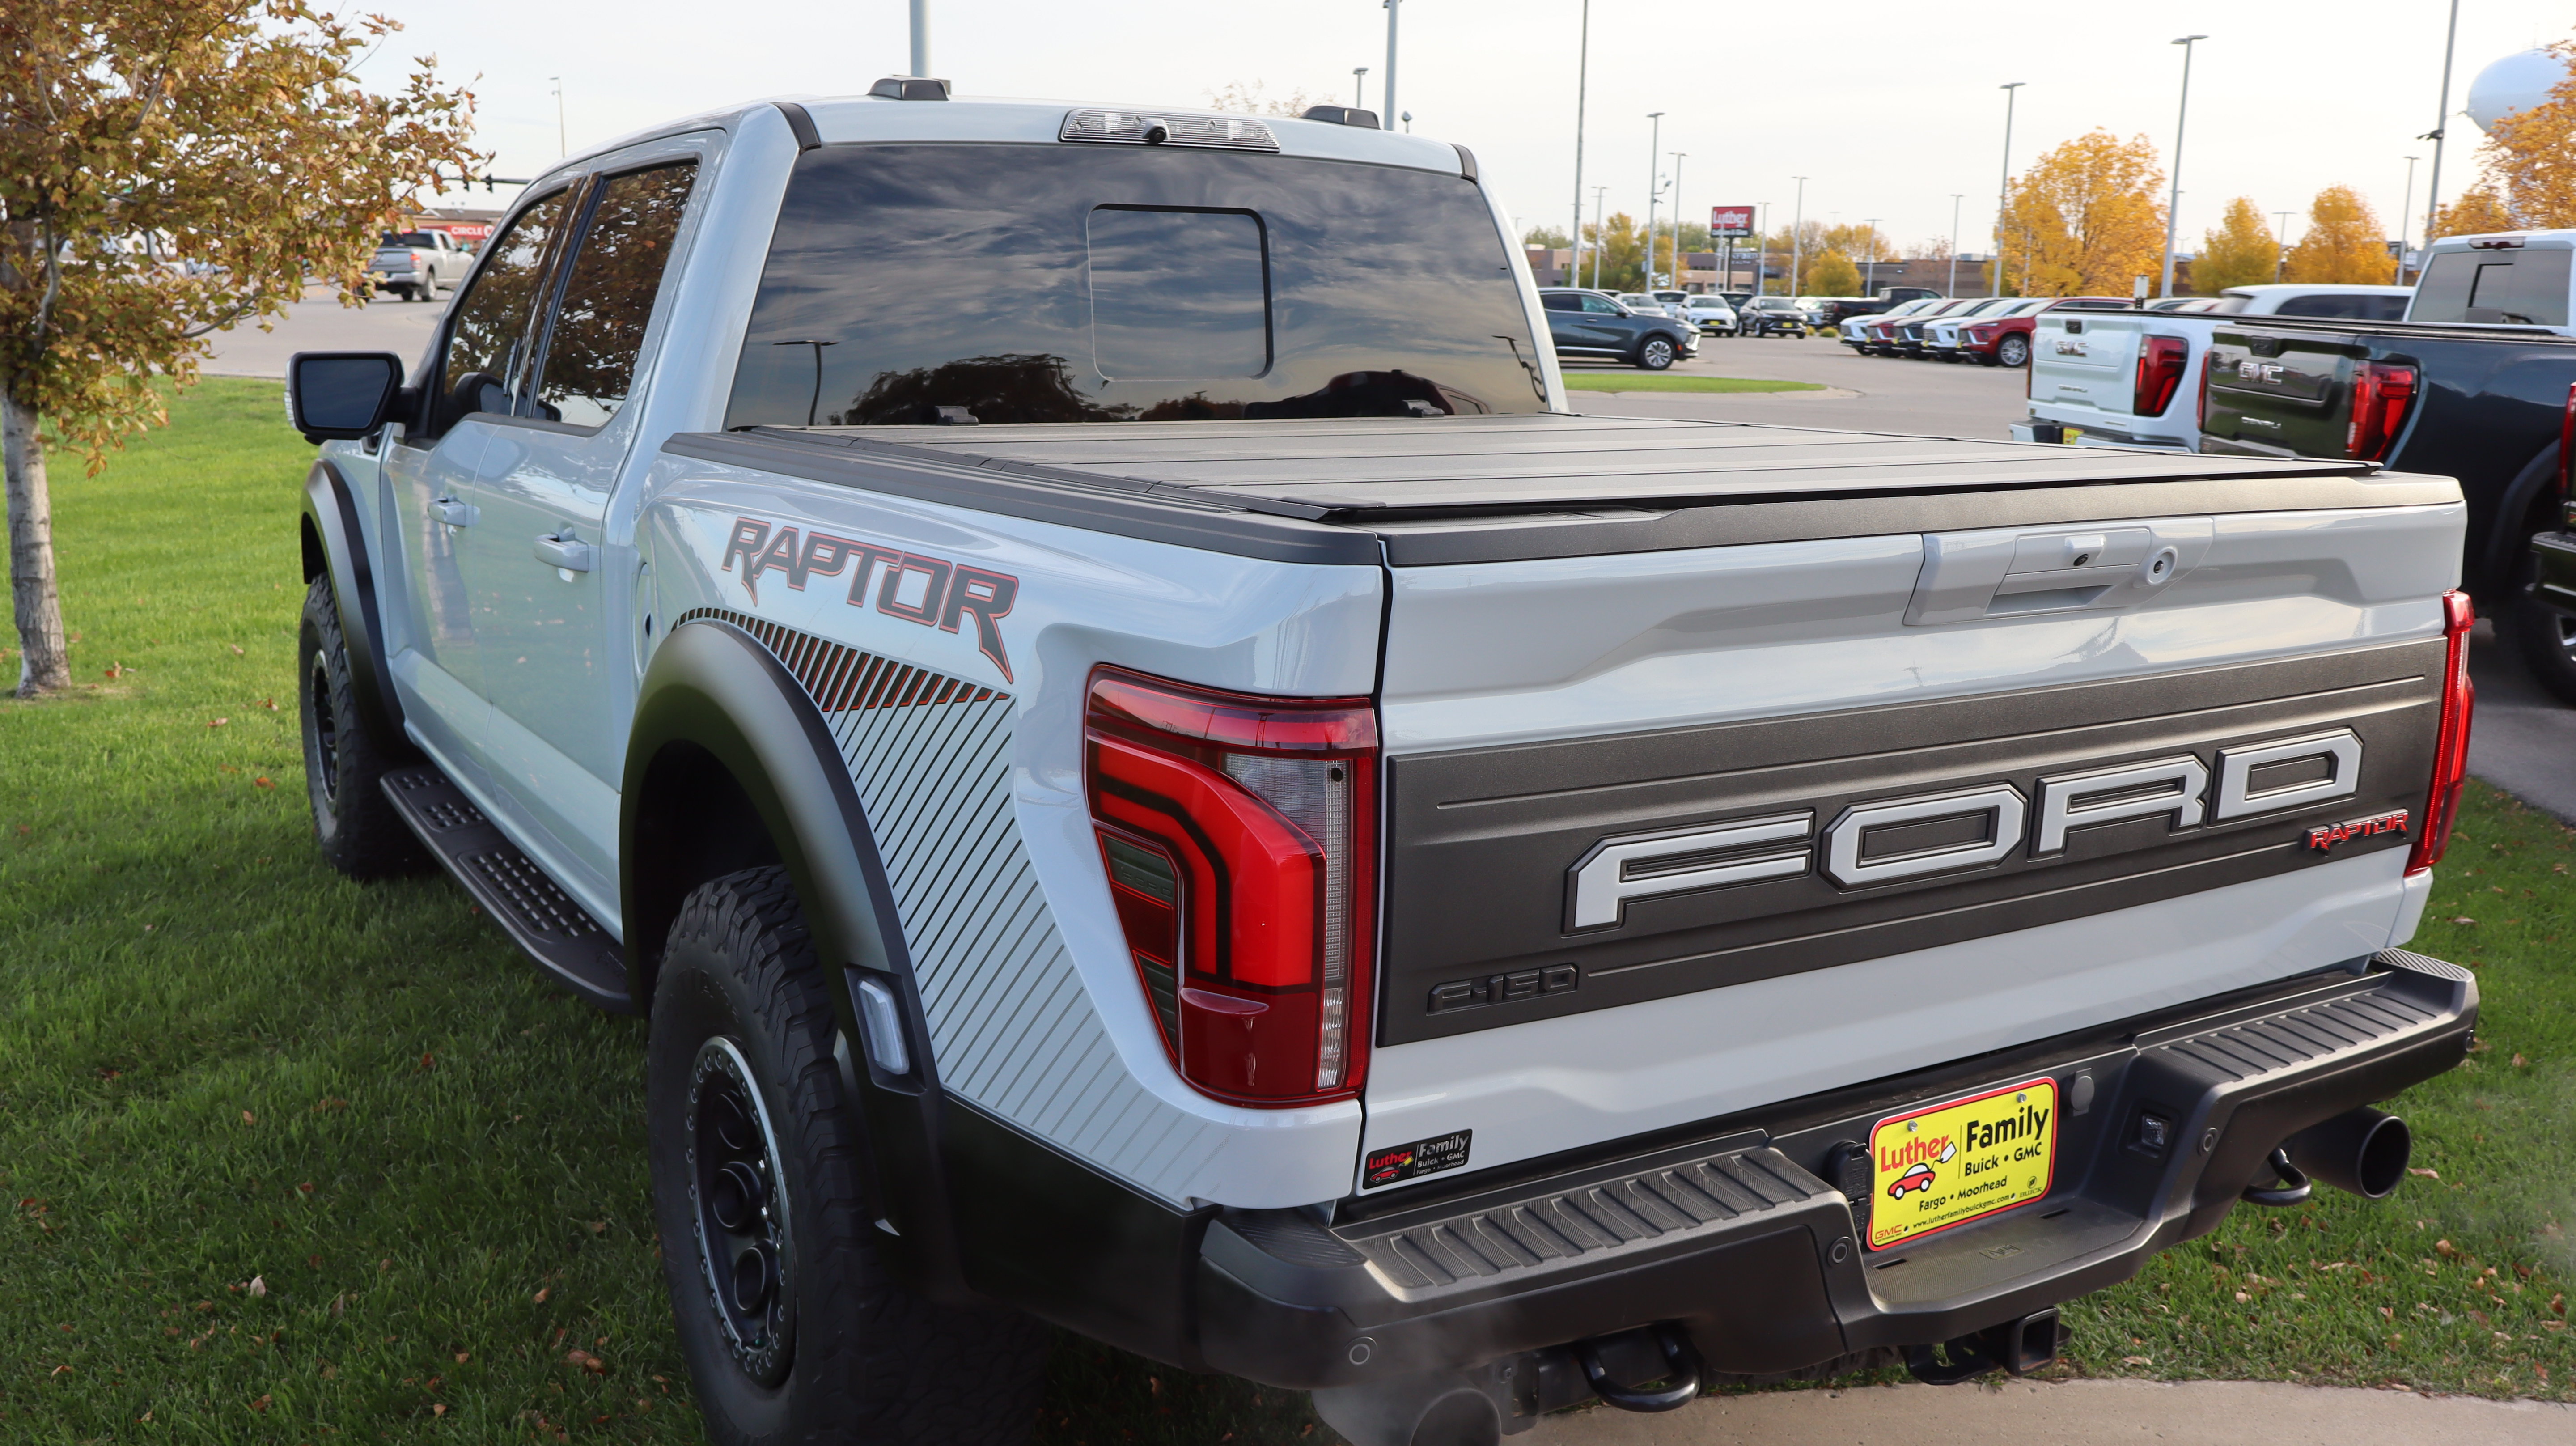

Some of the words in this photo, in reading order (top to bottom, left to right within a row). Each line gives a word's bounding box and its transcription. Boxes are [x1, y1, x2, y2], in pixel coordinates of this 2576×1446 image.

[1713, 211, 1748, 224] Luther
[451, 226, 483, 235] CIRCLE
[2056, 341, 2089, 357] GMC
[2239, 361, 2284, 385] GMC
[721, 516, 1019, 685] RAPTOR
[1565, 726, 2364, 933] FORD
[2306, 808, 2409, 852] RAPTOR
[1428, 963, 1578, 1014] F-150
[1966, 1105, 2049, 1153] Family
[1419, 1134, 1469, 1158] Family
[1881, 1134, 1949, 1173] Luther
[1368, 1150, 1413, 1170] Luther
[1417, 1157, 1439, 1168] Buick
[1446, 1150, 1465, 1161] GMC
[1437, 1159, 1464, 1170] Moorhead
[1965, 1155, 1999, 1177] Buick
[2014, 1142, 2042, 1162] GMC
[1919, 1196, 1946, 1212] Fargo
[1957, 1175, 2008, 1201] Moorhead
[2019, 1187, 2043, 1198] BUICK
[1913, 1194, 2010, 1229] www.lutherfamilybuickgmc.com
[1875, 1224, 1903, 1240] GMC
